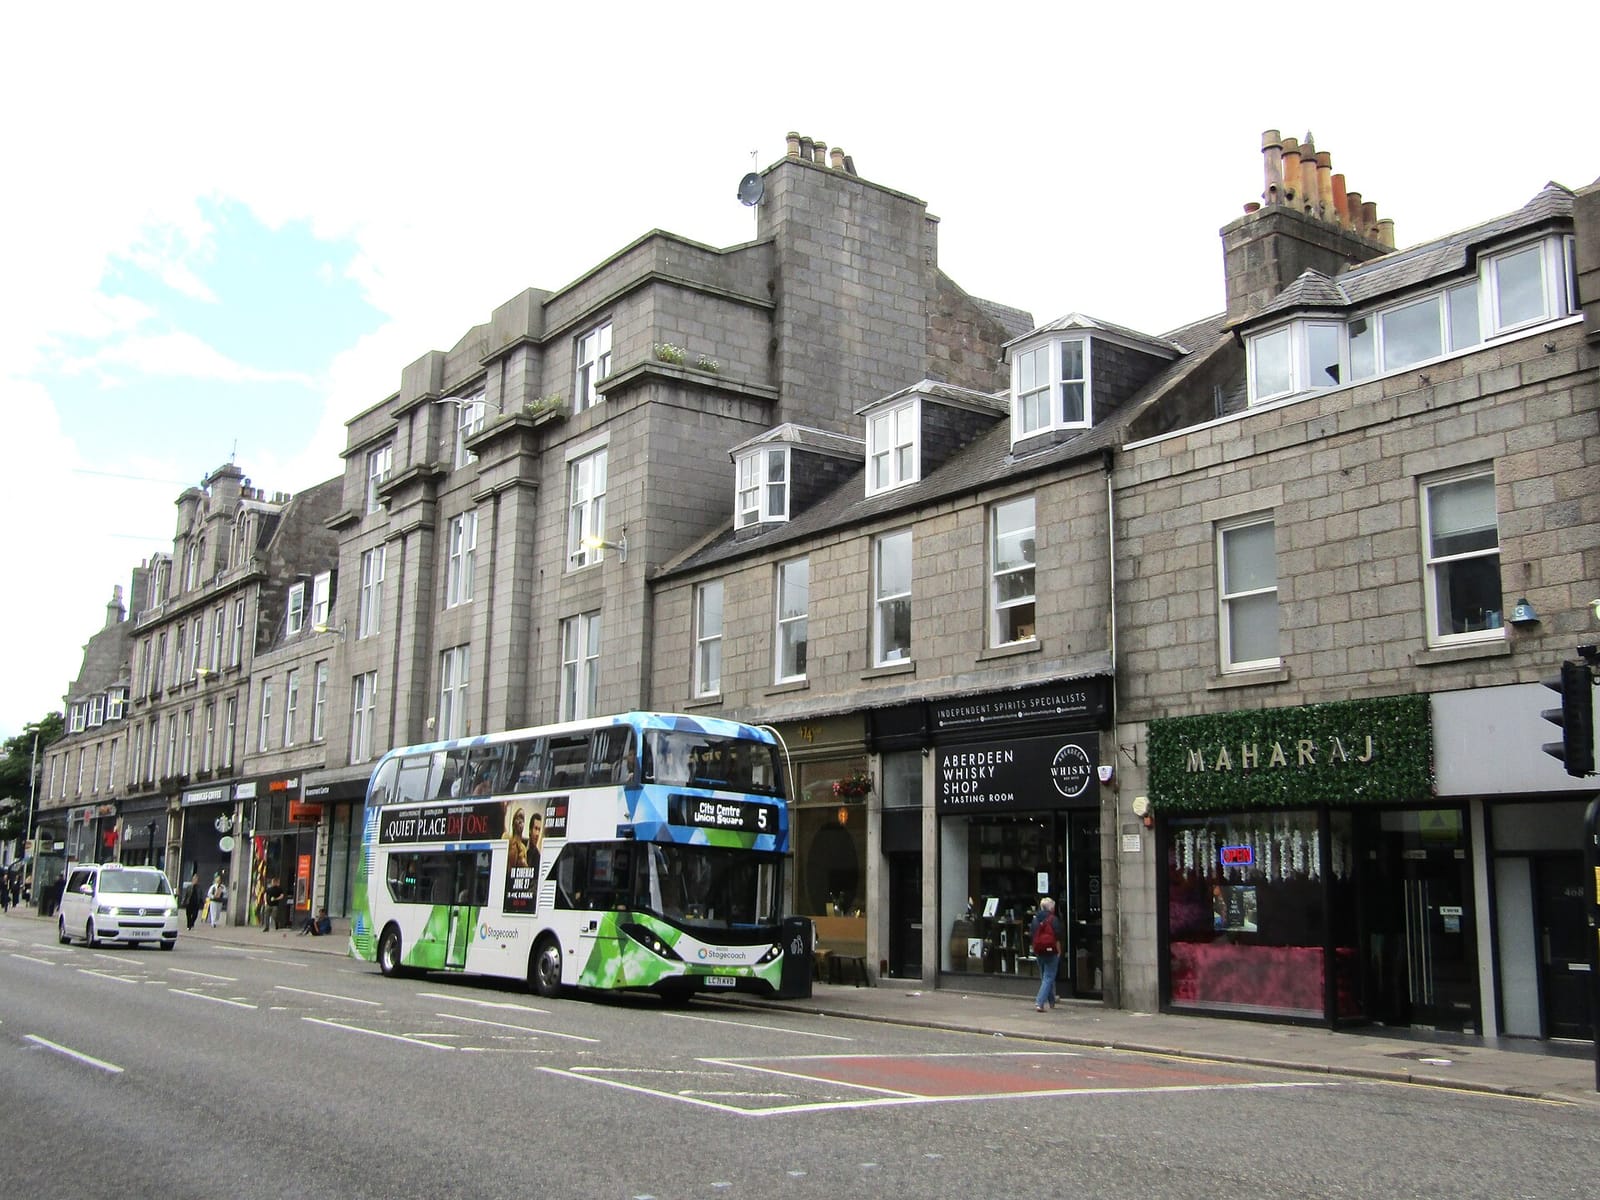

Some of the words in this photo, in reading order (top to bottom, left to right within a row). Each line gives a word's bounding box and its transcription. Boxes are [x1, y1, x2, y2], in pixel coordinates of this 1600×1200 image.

[937, 704, 990, 718] INDEPENDENT
[993, 700, 1026, 712] SPIRITS
[1030, 692, 1086, 707] SPECIALISTS
[943, 750, 1013, 767] ABERDEEN
[1185, 735, 1373, 773] MAHARAJ
[943, 765, 995, 781] WHISKY
[1050, 764, 1092, 777] WHISKY
[943, 780, 979, 795] SHOP
[950, 795, 985, 804] TASTING
[989, 793, 1014, 802] ROOM
[699, 802, 715, 814] City
[716, 805, 741, 817] Centre
[694, 812, 715, 823] Union
[716, 815, 744, 826] Square
[758, 809, 768, 828] 5
[384, 828, 389, 837] A
[388, 819, 416, 842] QUIET
[417, 817, 447, 836] PLACE
[467, 814, 488, 833] ONE
[1224, 848, 1250, 863] OPEN
[487, 926, 519, 940] Stagecoach
[708, 950, 746, 960] Stagecoach
